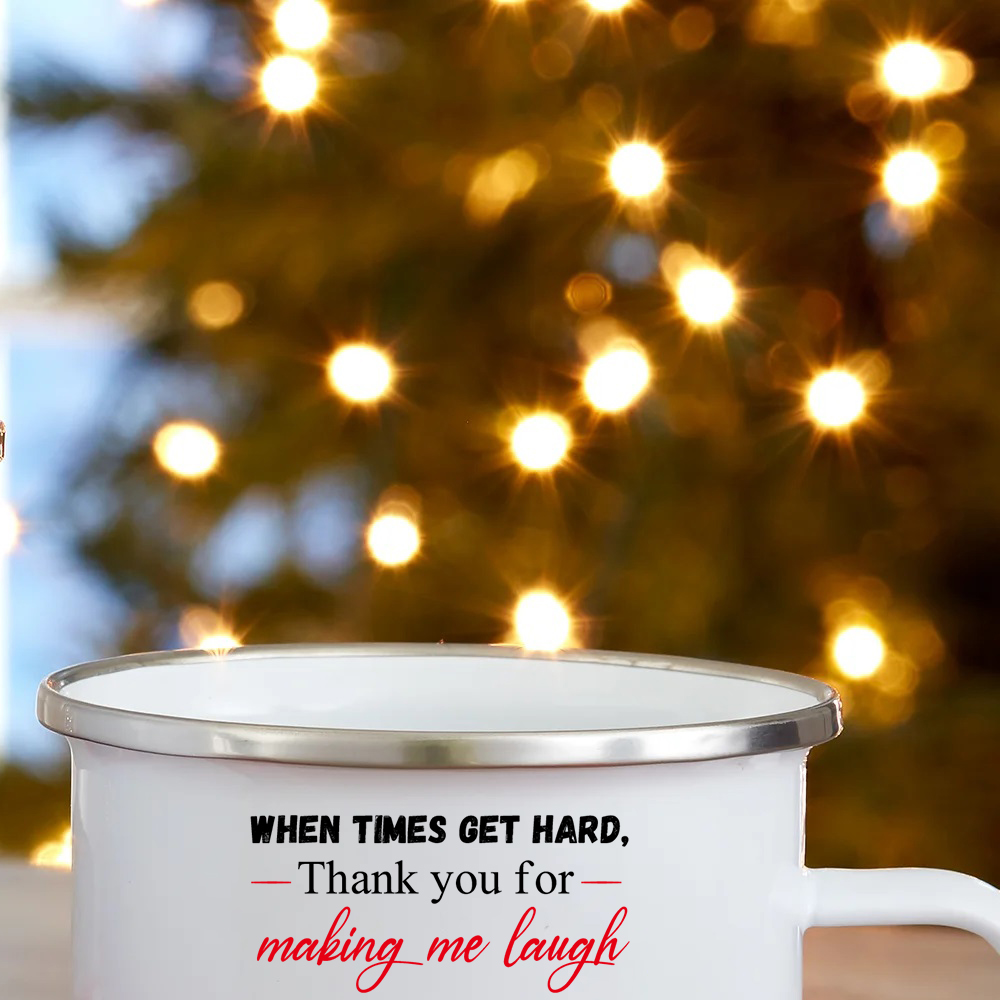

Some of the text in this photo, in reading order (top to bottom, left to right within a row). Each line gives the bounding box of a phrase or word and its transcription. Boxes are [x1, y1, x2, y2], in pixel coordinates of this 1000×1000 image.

[250, 814, 629, 848] WHEN TIMES GET HARD,
[297, 859, 575, 905] Thank you for
[256, 906, 630, 994] making me laugh
